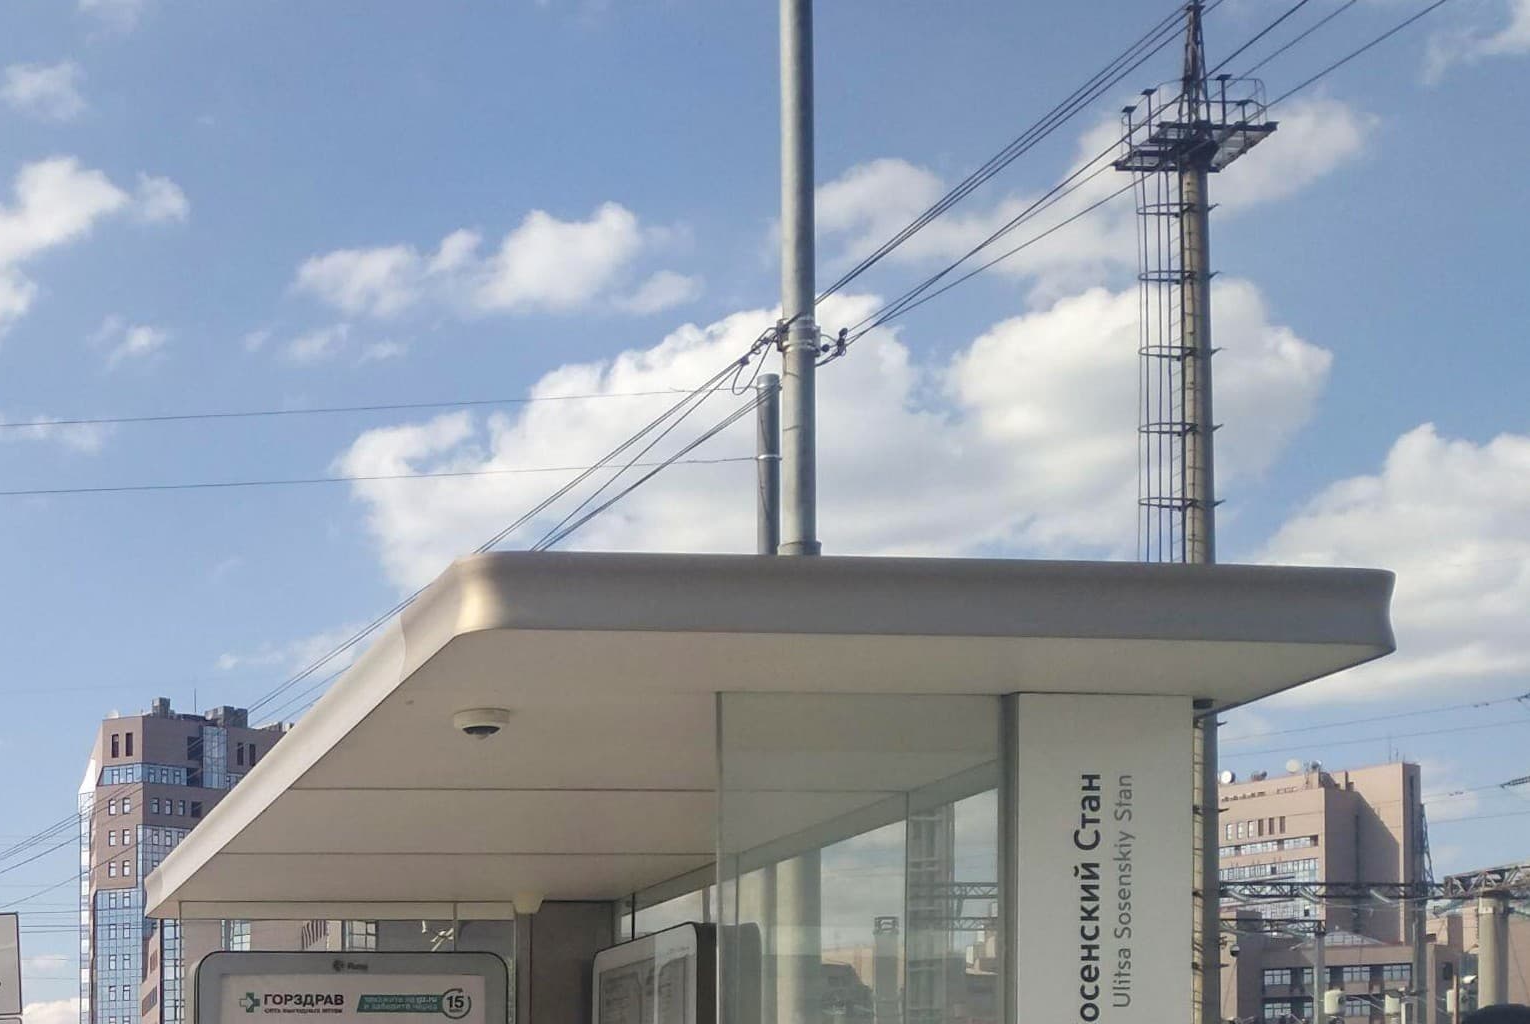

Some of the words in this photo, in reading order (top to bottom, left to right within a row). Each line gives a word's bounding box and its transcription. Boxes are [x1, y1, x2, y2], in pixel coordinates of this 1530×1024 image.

[1074, 773, 1102, 850] Стан
[1114, 774, 1134, 821] Stan
[1113, 829, 1136, 938] Sosenskiy
[264, 994, 344, 1006] ГОРЗДРАВ
[447, 995, 465, 1009] 15
[1113, 948, 1132, 1007] Ulitsa
